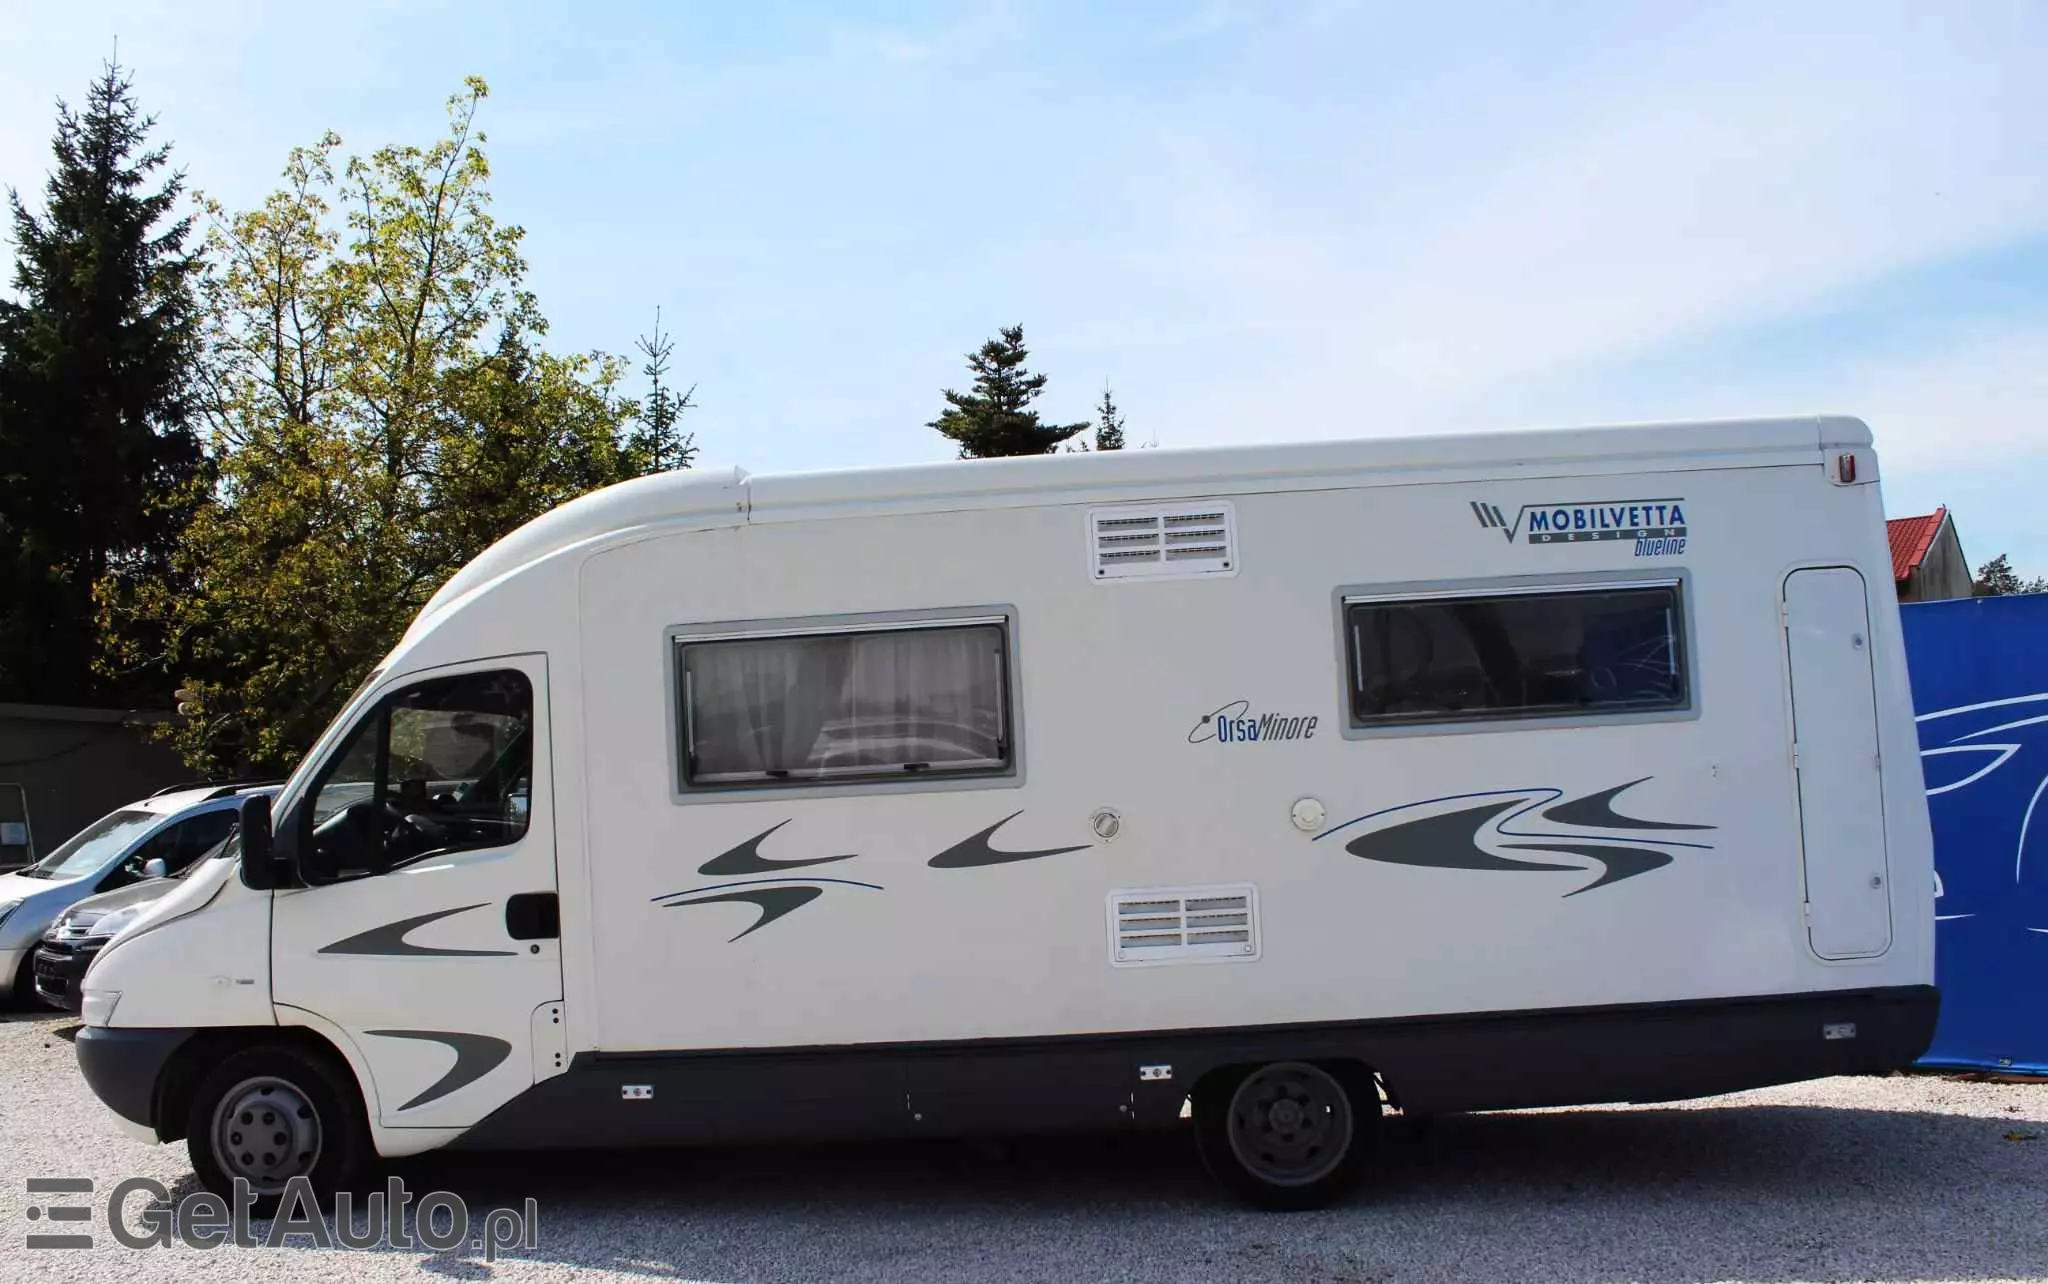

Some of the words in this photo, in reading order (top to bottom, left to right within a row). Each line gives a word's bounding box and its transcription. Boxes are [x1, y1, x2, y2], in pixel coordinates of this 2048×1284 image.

[1530, 505, 1685, 532] MOBILVETTA
[1541, 528, 1676, 542] DESIGN
[1634, 535, 1686, 557] blueline
